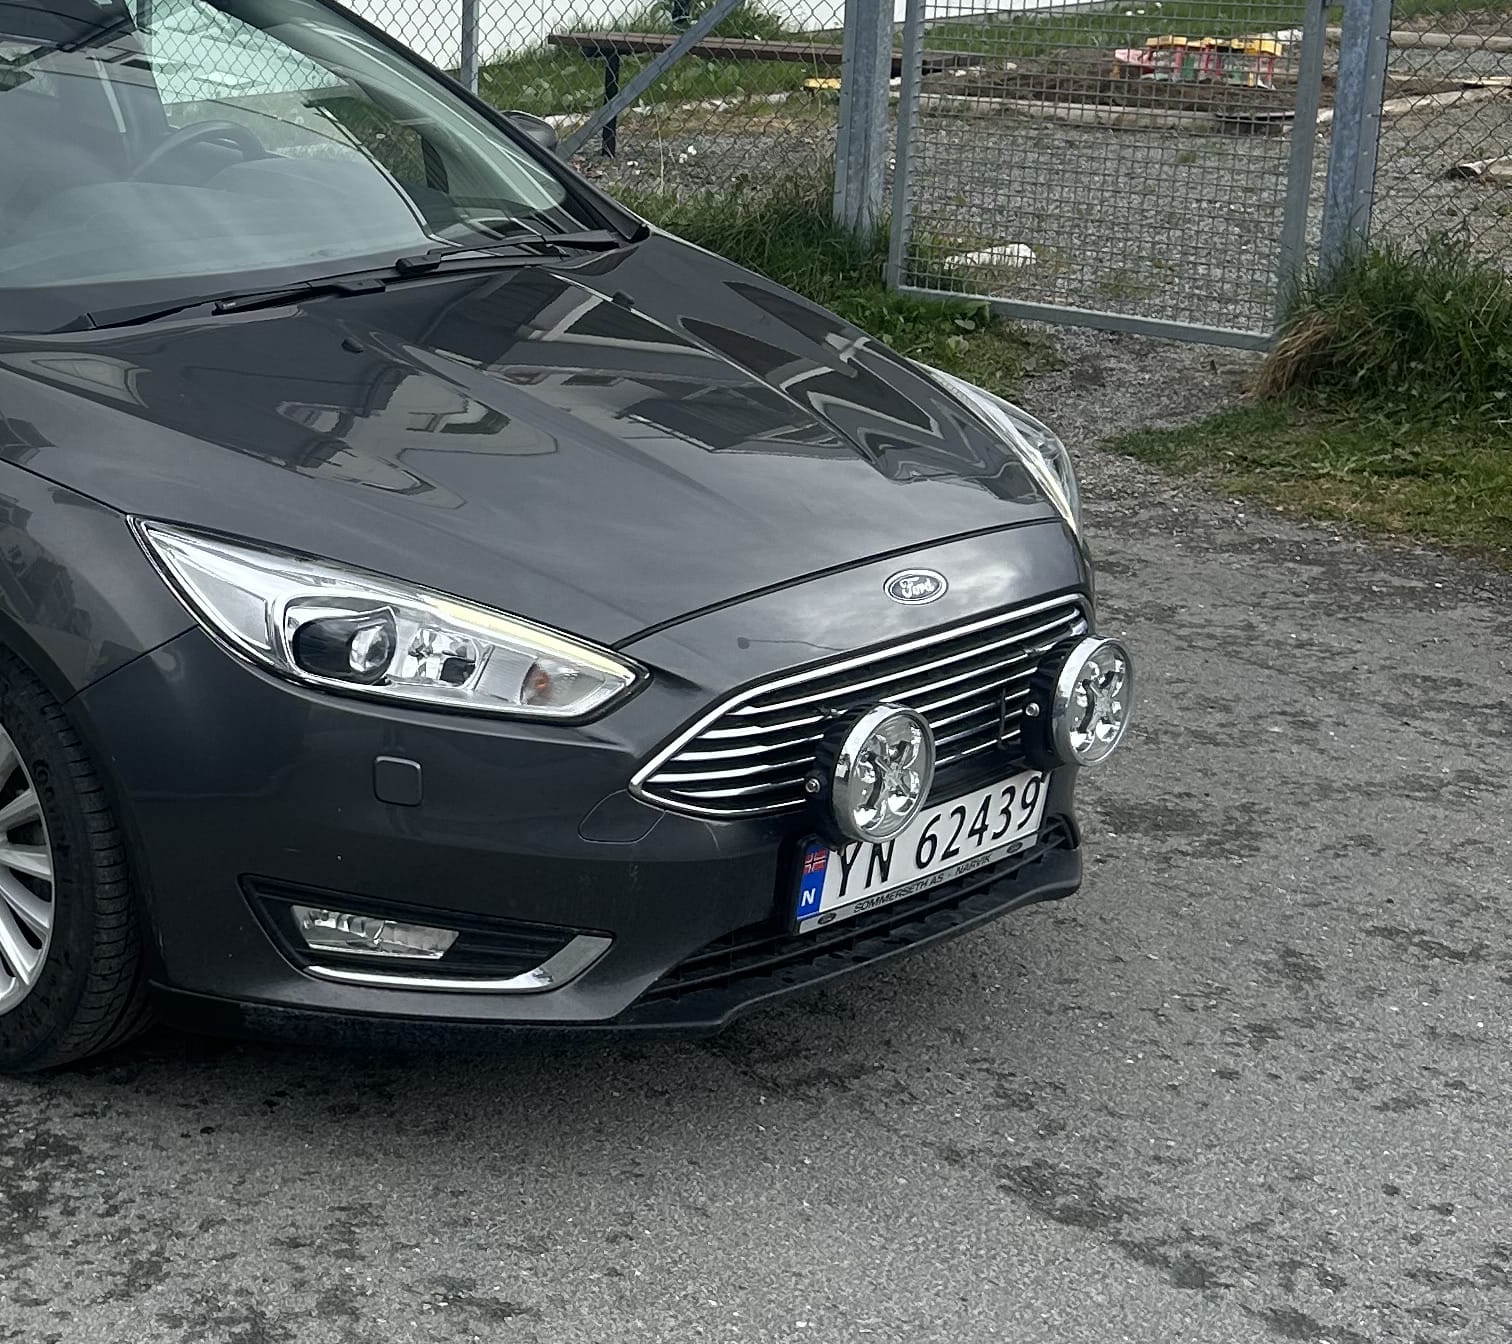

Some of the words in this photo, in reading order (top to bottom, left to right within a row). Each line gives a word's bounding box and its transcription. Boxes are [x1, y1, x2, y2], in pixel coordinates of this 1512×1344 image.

[899, 576, 935, 599] Ford
[839, 838, 896, 897] YN
[915, 775, 1041, 870] 62439
[928, 873, 945, 887] AS
[801, 888, 817, 907] N
